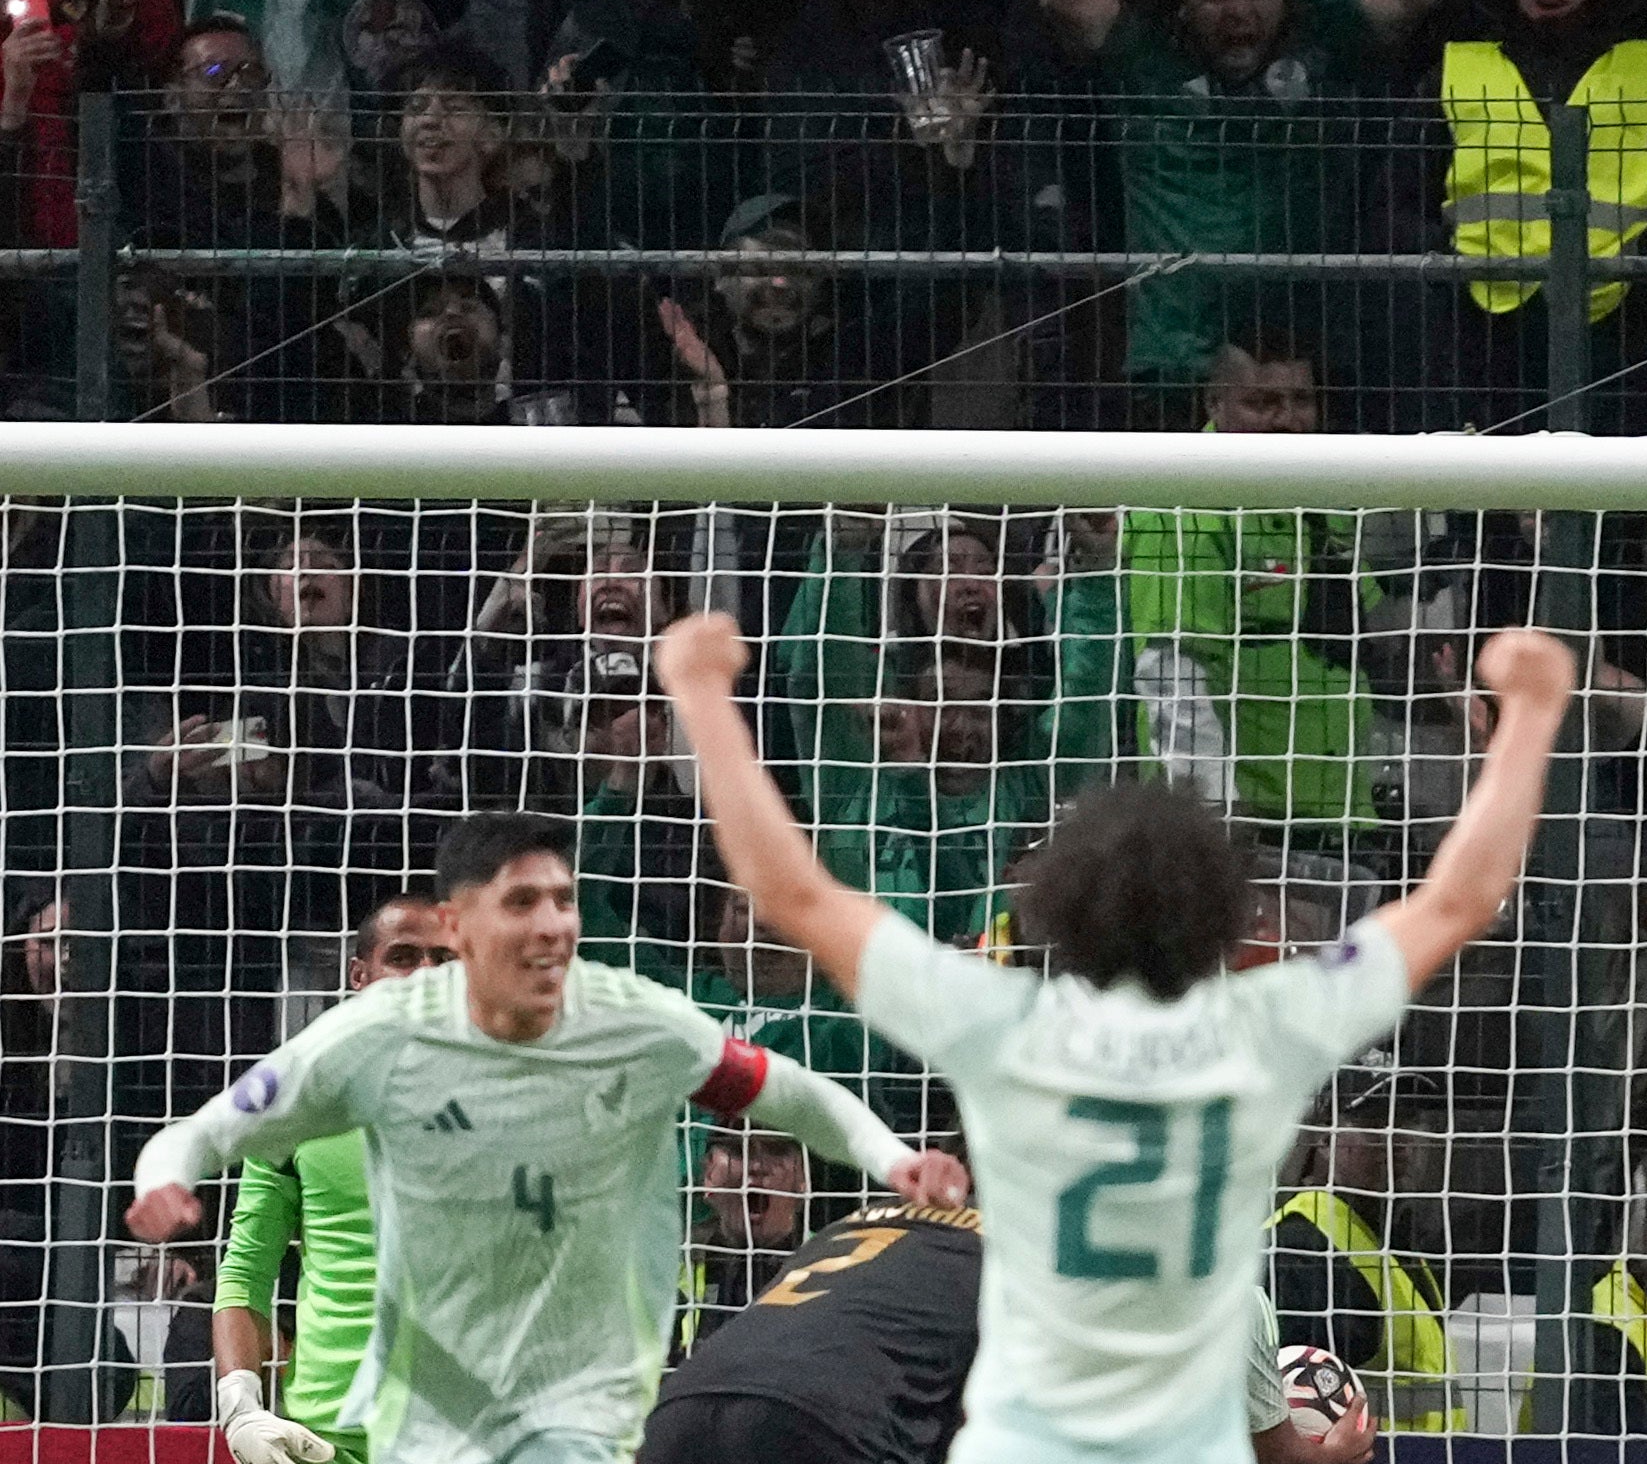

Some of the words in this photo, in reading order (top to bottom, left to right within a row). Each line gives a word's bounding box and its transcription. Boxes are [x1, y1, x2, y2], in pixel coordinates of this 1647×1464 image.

[512, 1165, 556, 1234] 4
[1056, 1094, 1236, 1278] 21
[754, 1226, 911, 1307] 2
